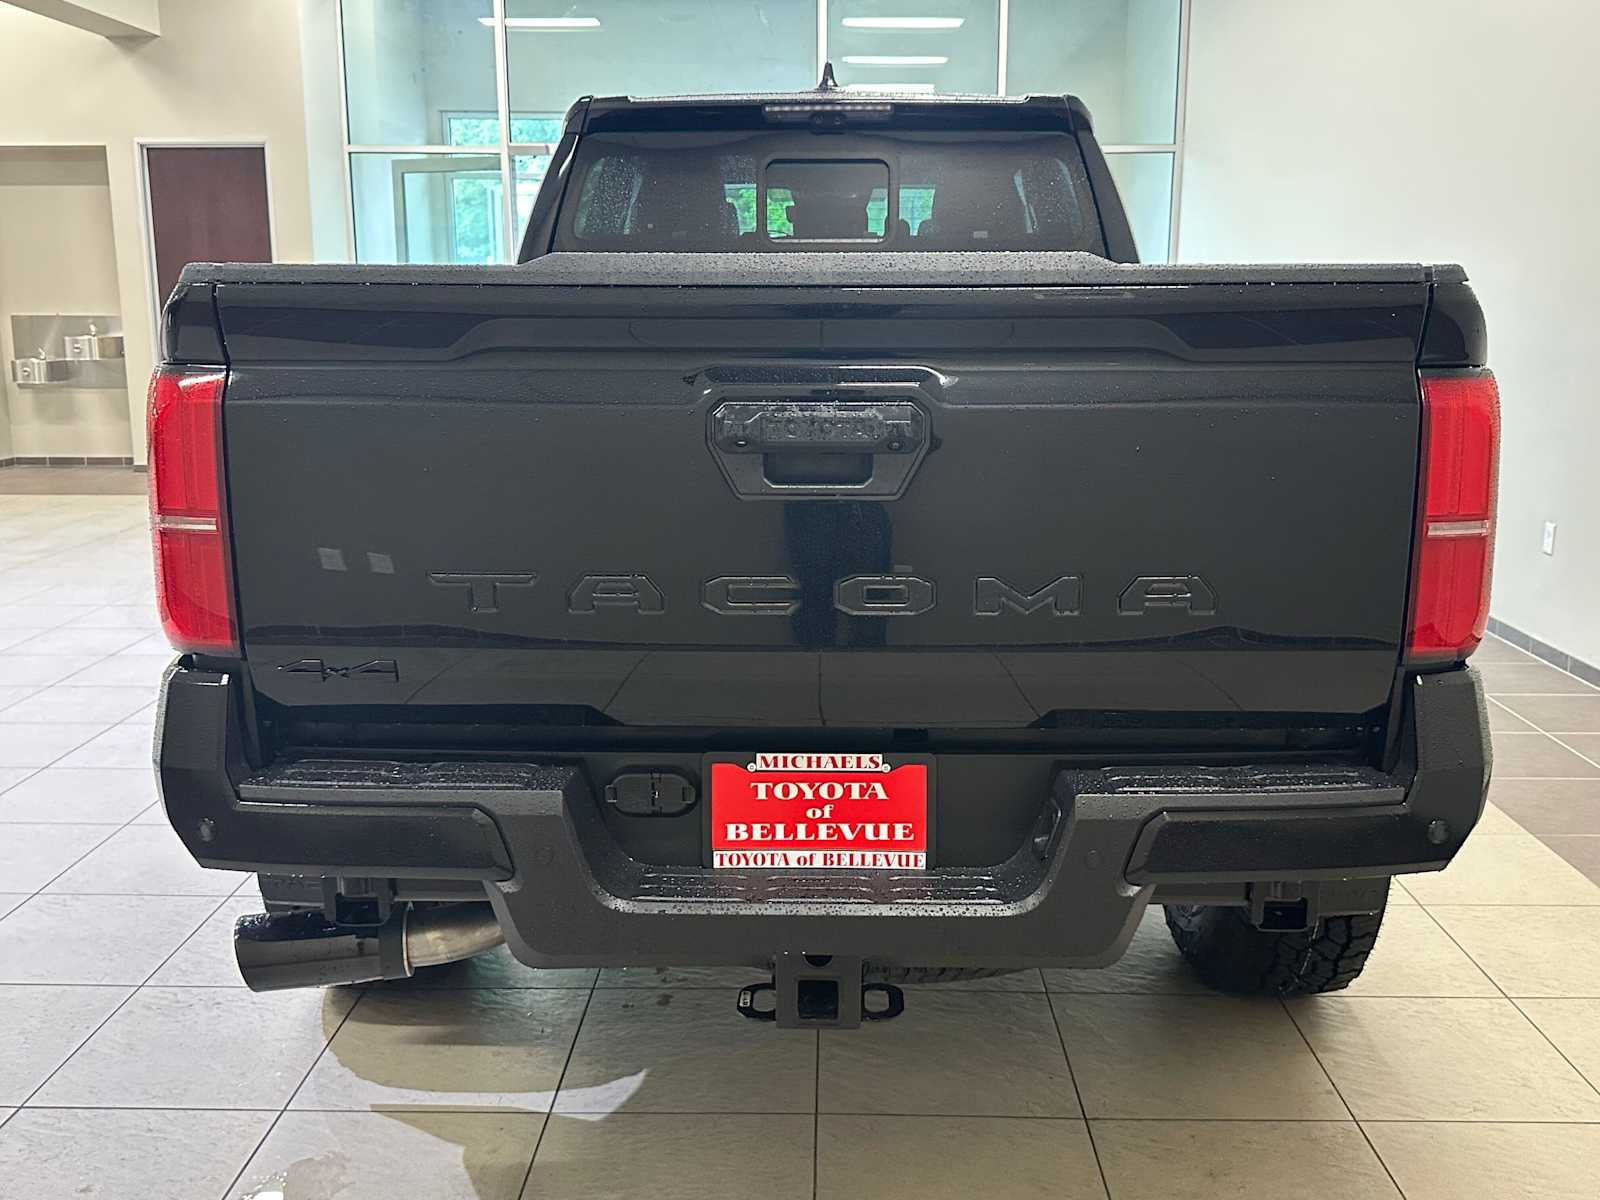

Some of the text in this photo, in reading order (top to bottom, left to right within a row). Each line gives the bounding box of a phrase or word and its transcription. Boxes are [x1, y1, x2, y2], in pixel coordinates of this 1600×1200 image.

[426, 571, 1217, 616] TACOMA
[760, 755, 880, 769] MICHAELS
[750, 782, 888, 800] TOYOTA
[806, 804, 834, 819] of
[725, 823, 914, 841] BELLEVUE
[715, 853, 924, 868] TOYOTA of BELLEVUE
